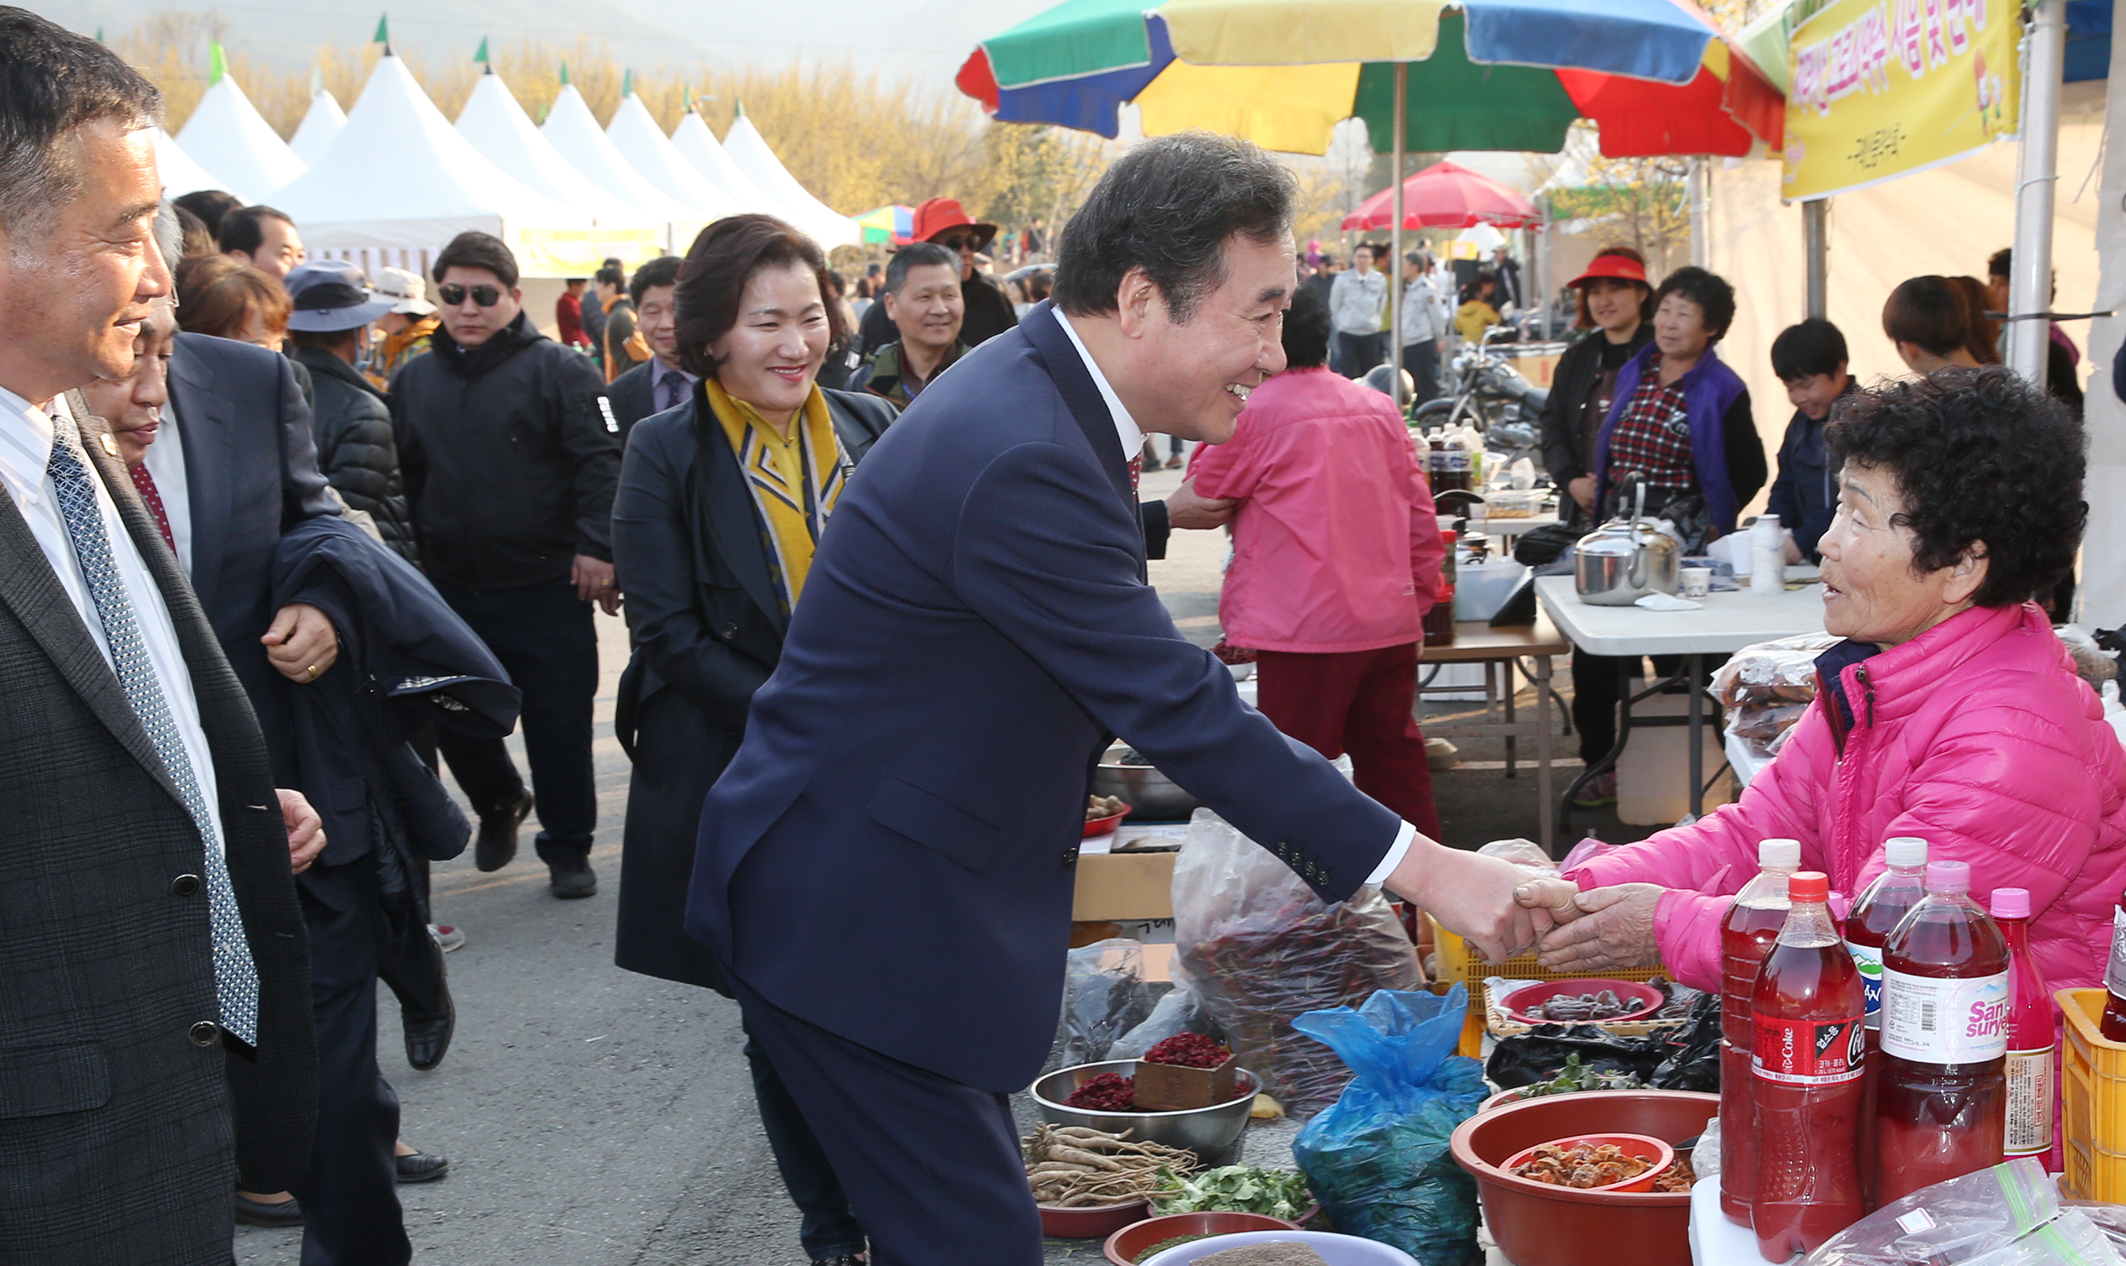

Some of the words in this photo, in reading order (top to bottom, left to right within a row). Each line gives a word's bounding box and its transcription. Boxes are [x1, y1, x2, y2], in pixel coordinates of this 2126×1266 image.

[1968, 1001, 2003, 1023] San
[1782, 1027, 1794, 1058] Coke
[1816, 1025, 1839, 1049] 업소용
